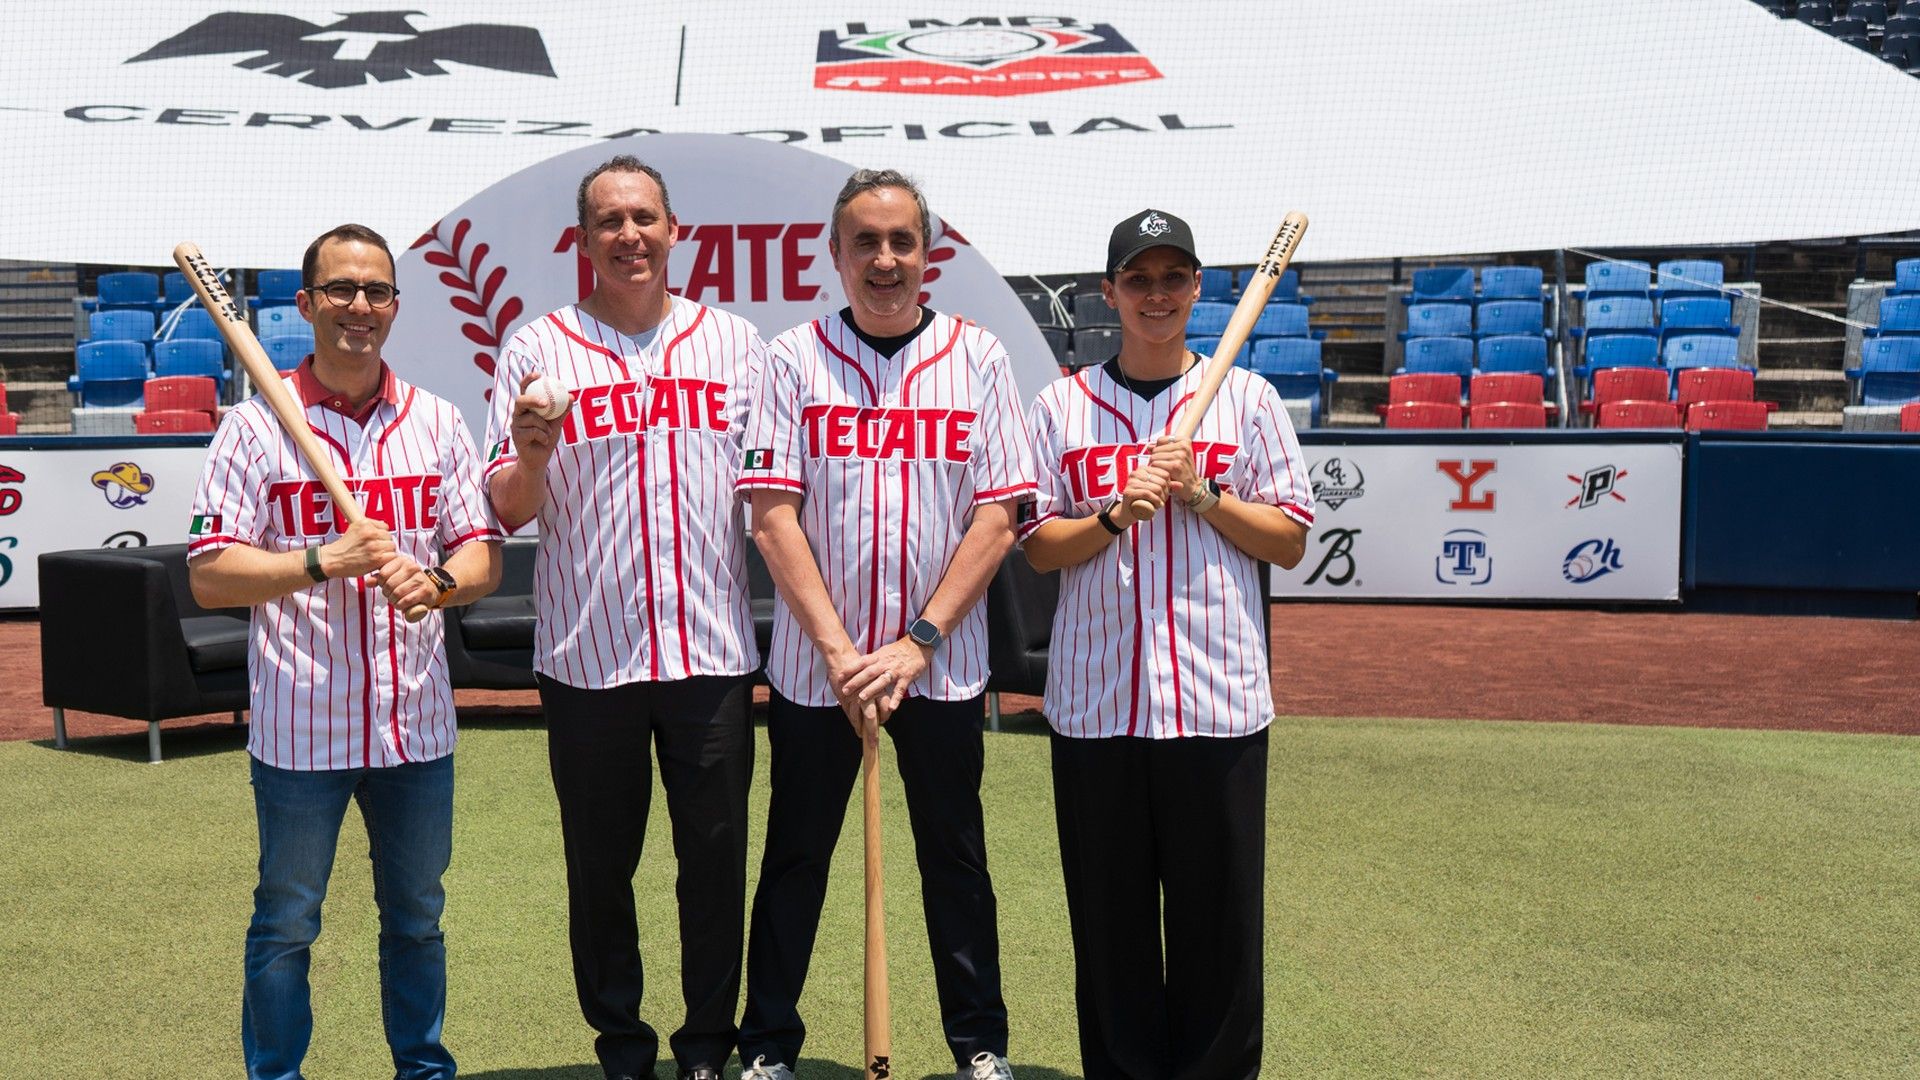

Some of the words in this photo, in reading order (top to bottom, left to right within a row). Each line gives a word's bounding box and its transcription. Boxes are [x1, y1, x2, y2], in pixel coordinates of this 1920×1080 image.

[899, 69, 1152, 87] BANORTE
[801, 405, 978, 462] TECATE
[1579, 464, 1617, 510] P
[1443, 541, 1486, 575] T
